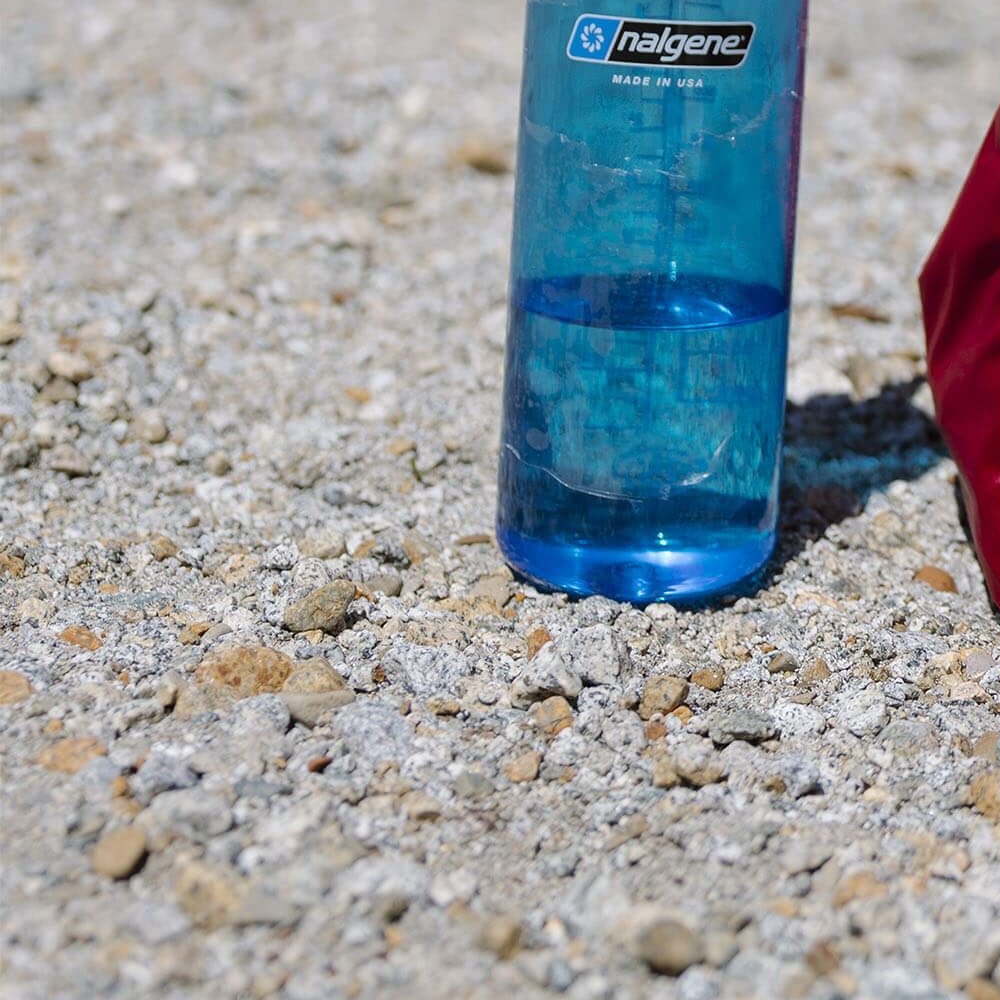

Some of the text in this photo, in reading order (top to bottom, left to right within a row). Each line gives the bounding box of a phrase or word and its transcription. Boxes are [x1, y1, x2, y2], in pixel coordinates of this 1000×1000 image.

[616, 27, 748, 62] nalgene
[612, 74, 704, 88] MADE IN USA
